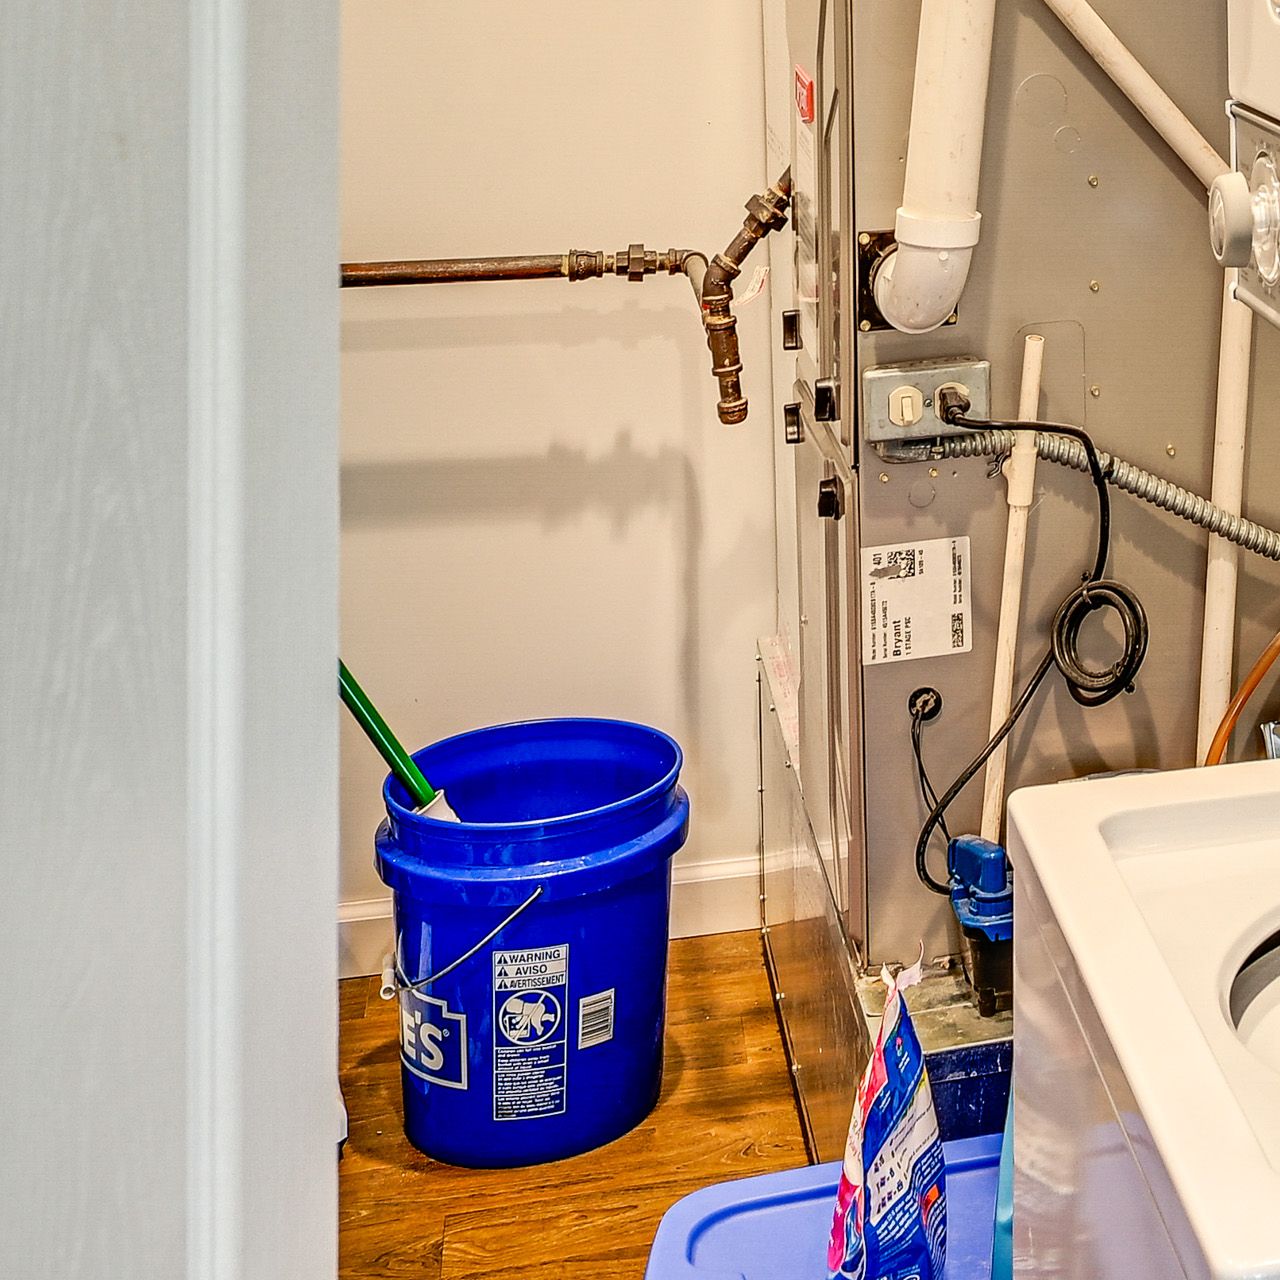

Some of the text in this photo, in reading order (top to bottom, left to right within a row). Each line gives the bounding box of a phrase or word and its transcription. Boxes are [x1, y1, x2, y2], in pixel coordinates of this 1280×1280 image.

[892, 620, 903, 656] Bryant
[509, 949, 561, 964] WARNING
[515, 964, 548, 976] AVISO
[509, 973, 565, 990] AVERTISSEMENT
